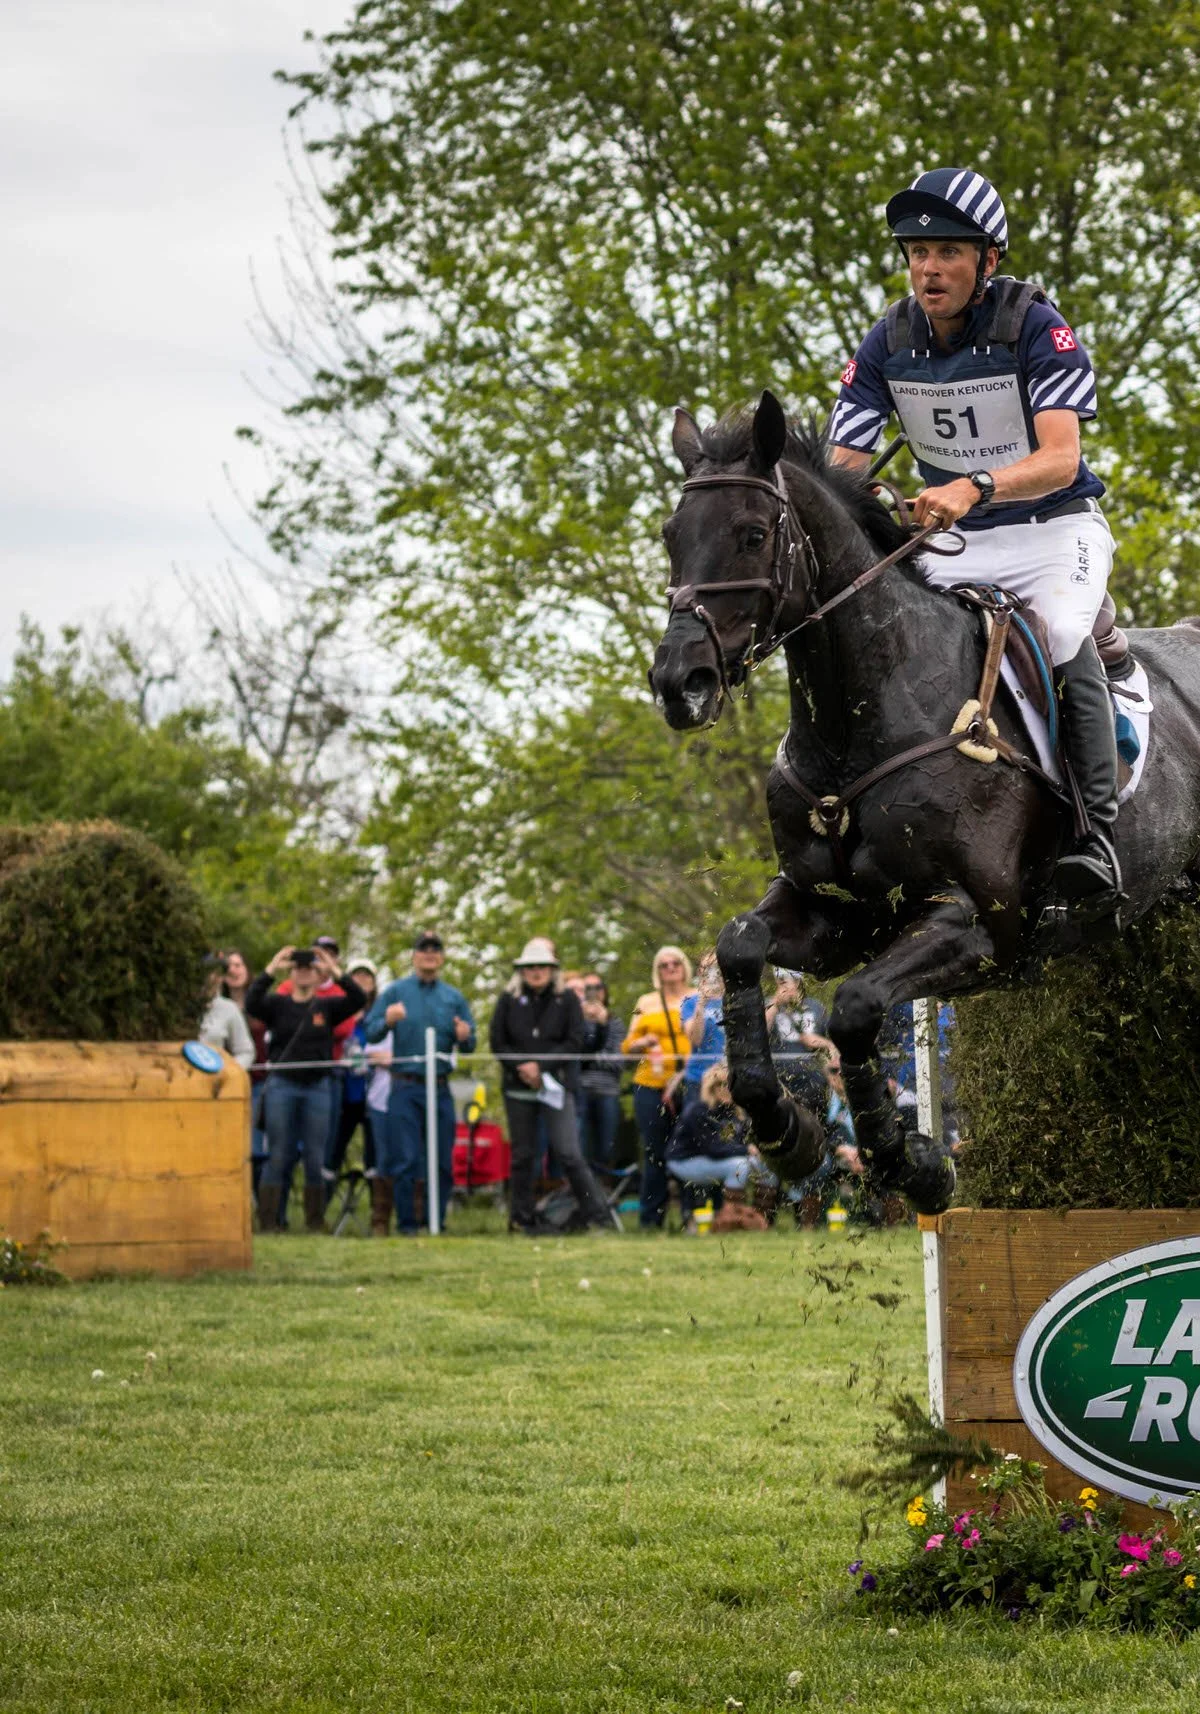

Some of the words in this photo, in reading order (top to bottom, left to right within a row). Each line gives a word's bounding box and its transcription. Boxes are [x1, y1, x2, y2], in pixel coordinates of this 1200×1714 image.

[893, 386, 919, 396] LAND
[921, 388, 955, 398] ROVER
[958, 380, 1014, 396] KENTUCKY
[932, 405, 980, 440] 51
[917, 441, 976, 458] THREE-DAY
[980, 442, 1019, 457] EVENT
[1077, 539, 1090, 576] ARIAT
